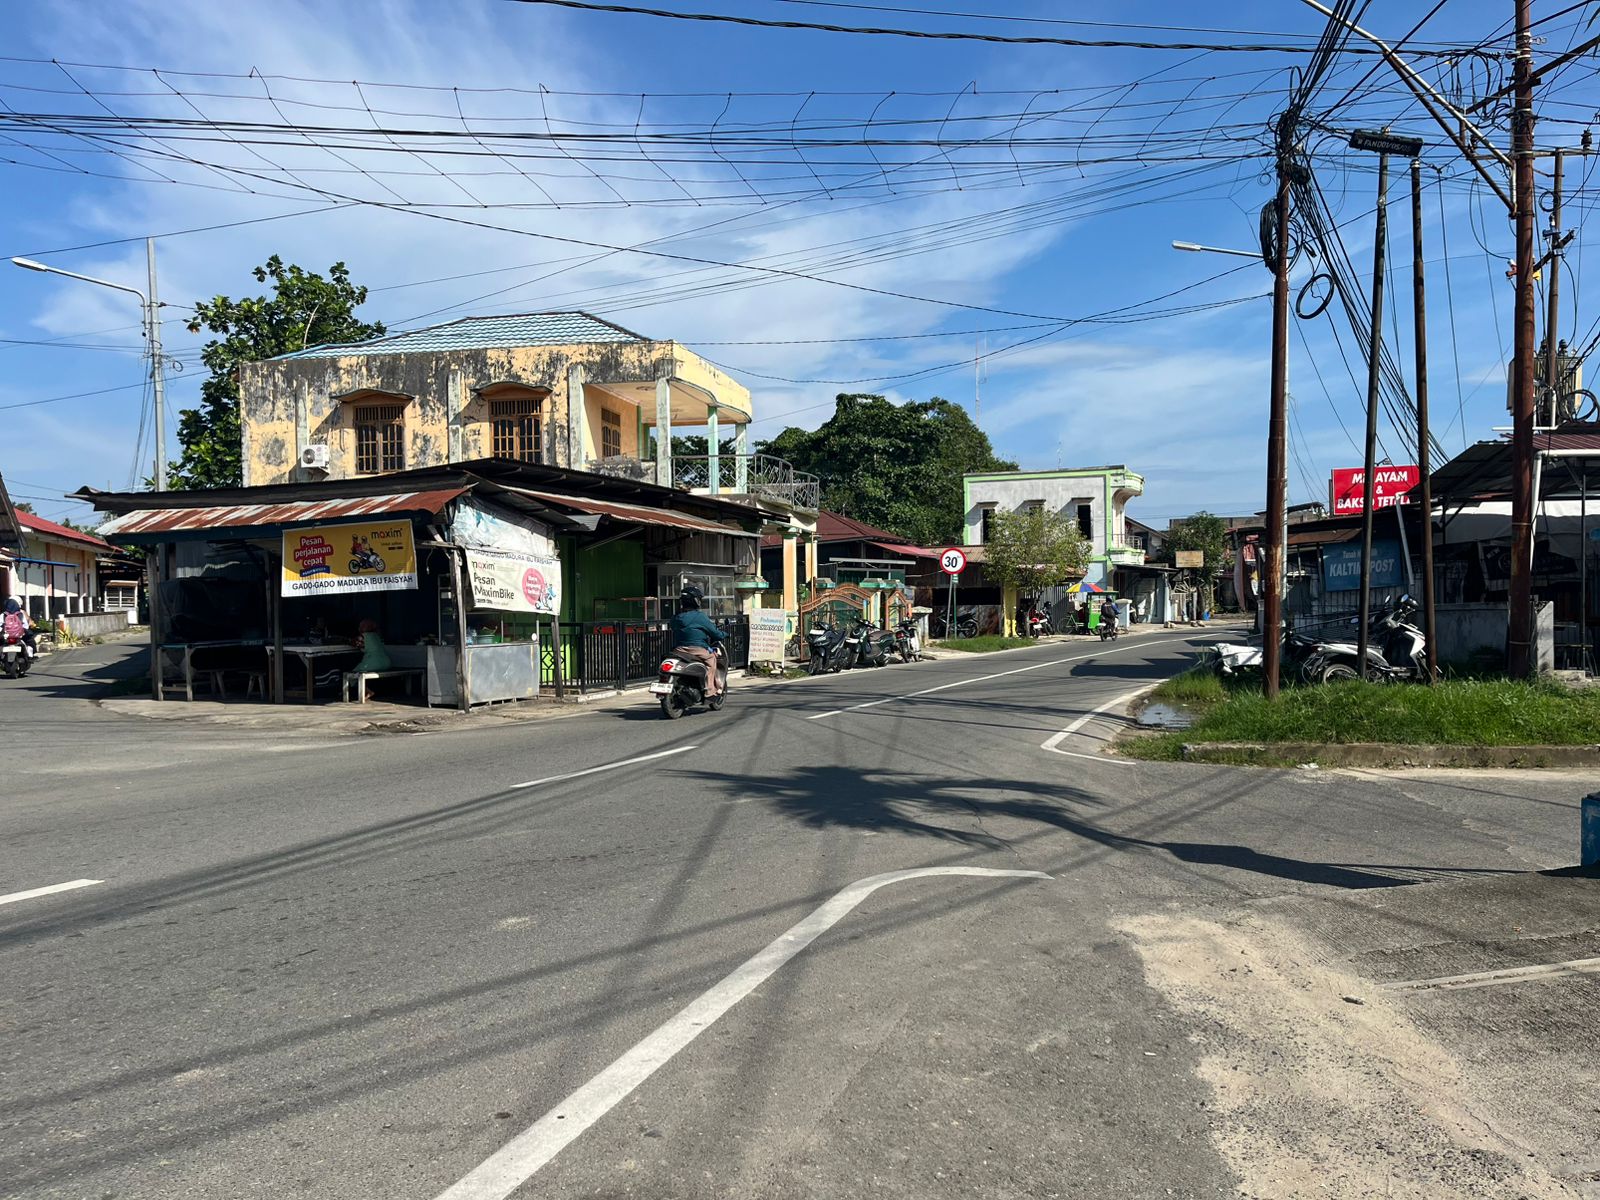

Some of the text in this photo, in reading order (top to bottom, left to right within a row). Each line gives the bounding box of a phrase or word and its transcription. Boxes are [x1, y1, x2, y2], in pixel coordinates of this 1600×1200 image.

[1375, 471, 1408, 483] AYAM
[1376, 485, 1384, 494] &
[1337, 496, 1375, 509] BAKS
[371, 528, 401, 539] maxim
[301, 537, 323, 546] Pesan
[295, 546, 332, 559] perjalanan
[303, 556, 323, 567] cepat
[944, 556, 958, 569] 30
[1370, 559, 1395, 574] POST
[292, 575, 413, 590] GADO-GADO MADURA IBU FAISYAH
[473, 572, 496, 586] Pesan
[474, 585, 515, 600] MaximBike
